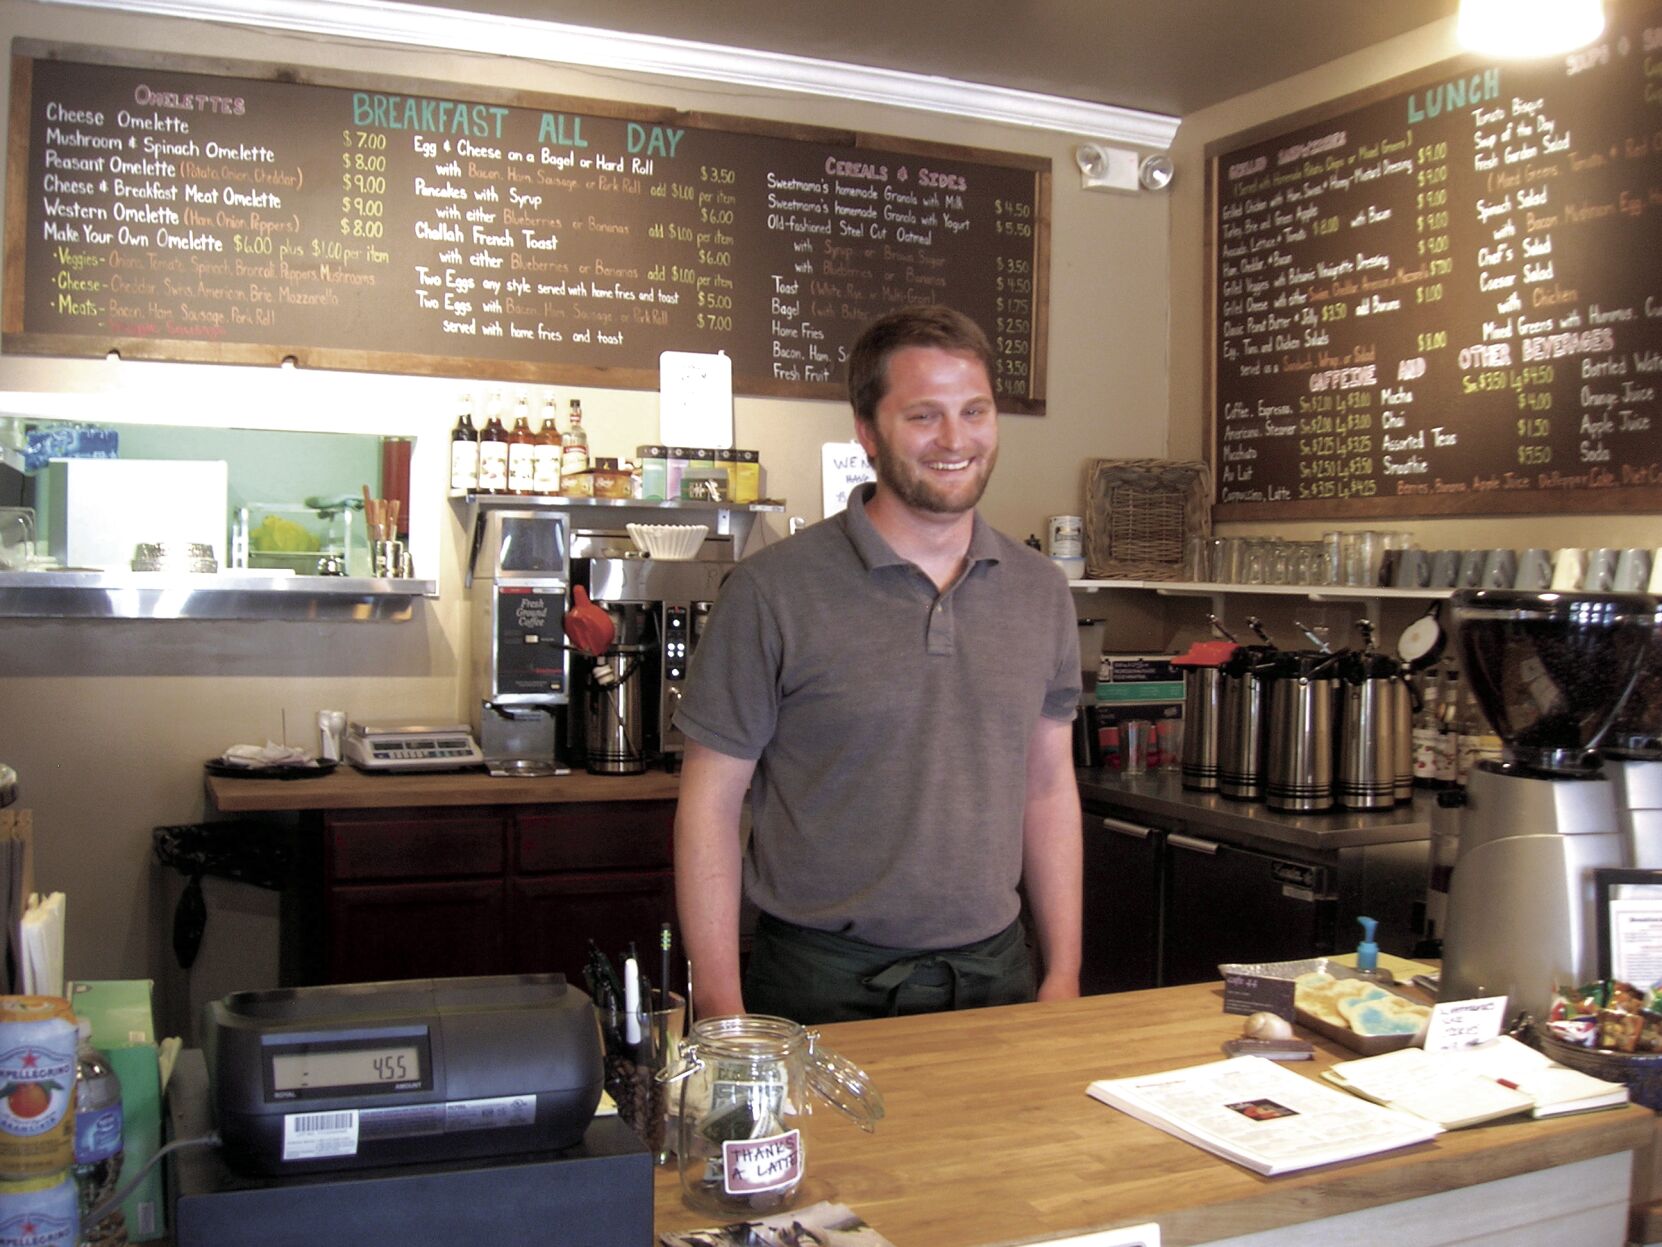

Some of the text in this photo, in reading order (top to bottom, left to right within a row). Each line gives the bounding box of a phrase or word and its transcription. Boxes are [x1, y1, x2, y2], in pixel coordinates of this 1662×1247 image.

[1408, 67, 1500, 125] LUNCH
[47, 104, 189, 134] Cheese Omelette
[352, 92, 684, 158] BREAKFAST ALL DAY
[1474, 114, 1555, 150] Soup of the Day
[46, 128, 122, 151] Mushroom
[144, 137, 199, 159] Spinach
[206, 142, 275, 162] Omelette
[1543, 130, 1570, 154] Salad
[46, 151, 104, 172] Peasant
[110, 156, 176, 178] Omelette
[414, 136, 436, 157] Egg
[457, 139, 501, 159] Cheese
[541, 148, 574, 170] Bagel
[596, 154, 623, 173] Hard
[632, 159, 653, 175] Roll
[436, 161, 461, 177] with
[825, 156, 967, 191] CEREALS SIDES
[44, 174, 94, 194] Cheese
[115, 178, 177, 201] Breakfast
[185, 184, 219, 203] Meat
[224, 188, 280, 209] Omelette
[415, 178, 467, 199] Pancakes
[474, 185, 498, 202] with
[510, 188, 542, 209] Syrup
[836, 181, 878, 200] homemade
[884, 186, 917, 206] Granola
[923, 192, 939, 207] with
[946, 194, 963, 210] Milk
[1517, 185, 1547, 209] Salad
[44, 198, 107, 221] Western
[114, 205, 179, 225] Omelette
[436, 205, 461, 221] with
[466, 206, 496, 224] either
[835, 201, 877, 219] homemade
[884, 204, 916, 224] Granola
[922, 211, 938, 226] with
[944, 214, 970, 234] Yogurt
[44, 223, 79, 242] Make
[82, 224, 113, 246] Your
[118, 228, 148, 247] Own
[157, 231, 223, 252] Omelette
[280, 240, 304, 261] plus
[415, 222, 464, 243] Challah
[473, 226, 514, 247] French
[522, 229, 558, 250] Toast
[794, 239, 813, 252] with
[840, 220, 864, 238] Steel
[870, 223, 886, 240] Cut
[897, 227, 932, 245] Oatmeal
[439, 250, 462, 265] with
[470, 250, 503, 268] either
[1522, 234, 1552, 258] Salad
[795, 261, 813, 274] with
[1523, 261, 1554, 284] Salad
[415, 266, 441, 286] Two
[446, 268, 474, 292] Eggs
[483, 279, 501, 294] any
[507, 278, 531, 296] style
[538, 279, 566, 296] served
[568, 279, 587, 297] with
[592, 283, 614, 299] home
[615, 283, 635, 301] fries
[639, 288, 654, 303] and
[658, 291, 679, 305] toast
[772, 276, 798, 294] Toast
[415, 290, 439, 309] Two
[445, 293, 472, 317] Eggs
[483, 299, 502, 314] with
[772, 298, 800, 320] Bagel
[443, 318, 623, 345] served with home fries and toast
[772, 320, 798, 338] Home
[802, 322, 824, 340] Fries
[1518, 316, 1553, 335] Greens
[1560, 310, 1581, 328] with
[1459, 328, 1614, 370] OTHER BEVERAGES
[774, 362, 829, 382] Fresh Fruit
[1309, 364, 1378, 392] CAFFEINE
[1622, 381, 1655, 403] Juice
[1382, 410, 1406, 430] Chai
[1580, 410, 1650, 439] Apple Juice
[1383, 427, 1458, 452] Assorted Teas
[1580, 440, 1610, 462] Soda
[731, 1137, 795, 1162] THANKS
[732, 1168, 745, 1180] A
